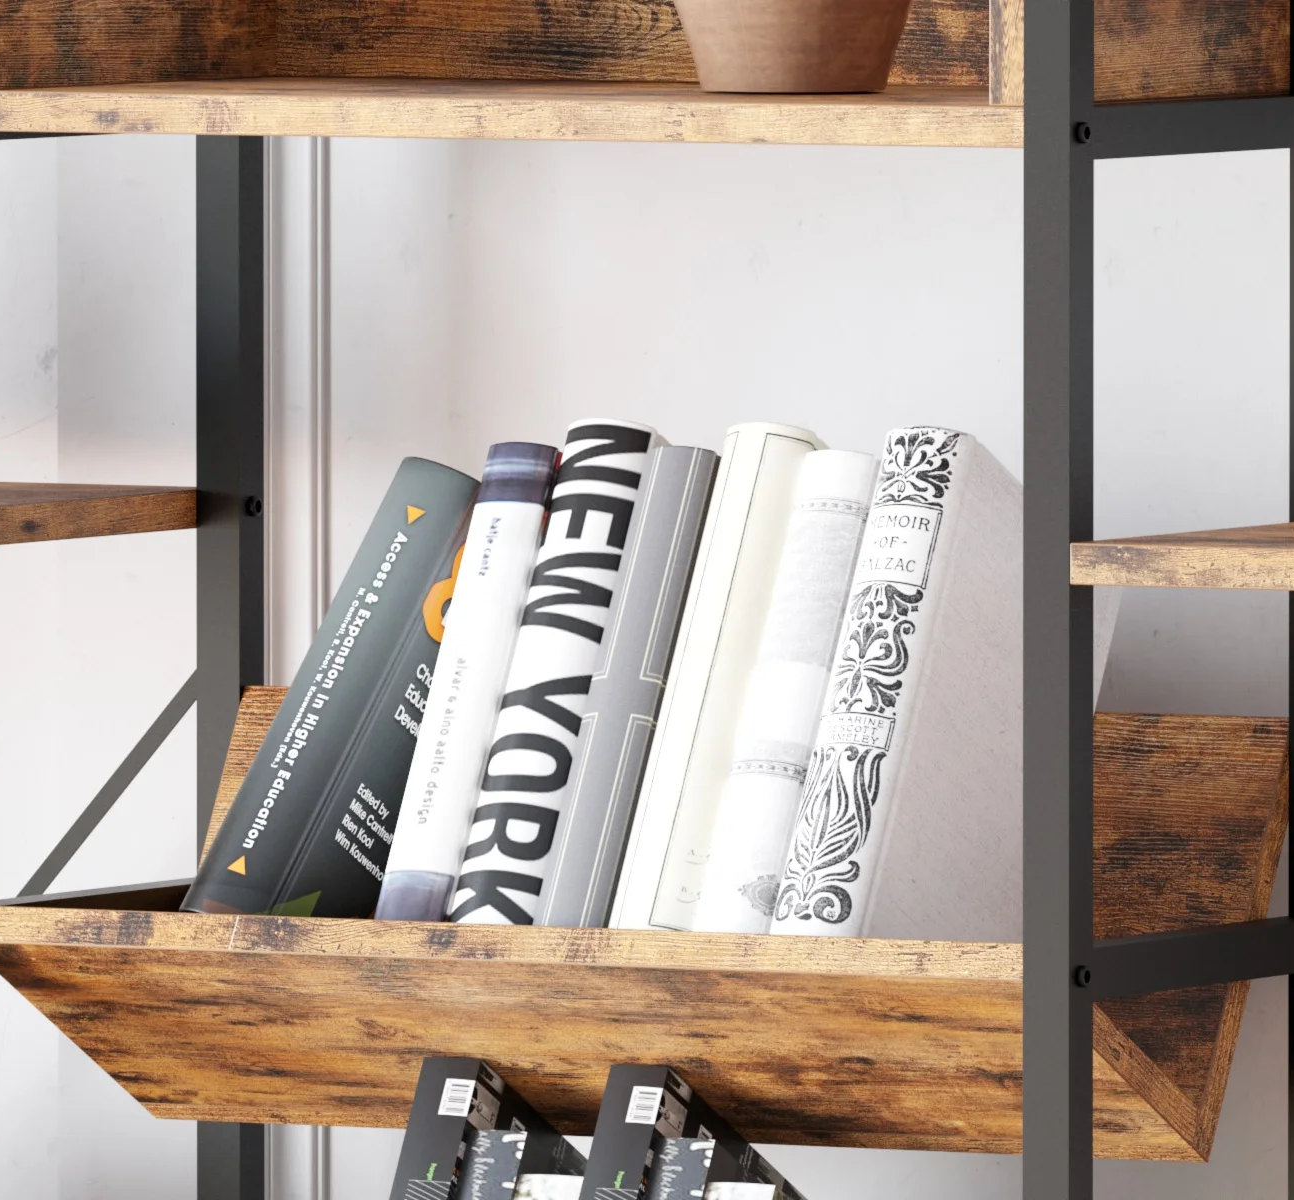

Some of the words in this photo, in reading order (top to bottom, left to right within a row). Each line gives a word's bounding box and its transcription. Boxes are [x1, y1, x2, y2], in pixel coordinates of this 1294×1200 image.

[371, 531, 409, 589] Access
[520, 424, 652, 645] NEW
[862, 557, 917, 573] ALZAC
[364, 592, 380, 605] &
[320, 608, 372, 690] Expansion
[311, 692, 330, 710] in
[284, 715, 320, 767] Higher
[242, 769, 292, 850] Education
[348, 797, 367, 820] Mike
[356, 782, 381, 810] Edited
[377, 802, 390, 820] by
[450, 674, 593, 926] YORK
[334, 828, 351, 851] Wim
[349, 842, 384, 882] Kouwenho
[341, 813, 358, 836] Rien
[356, 827, 375, 850] Kool
